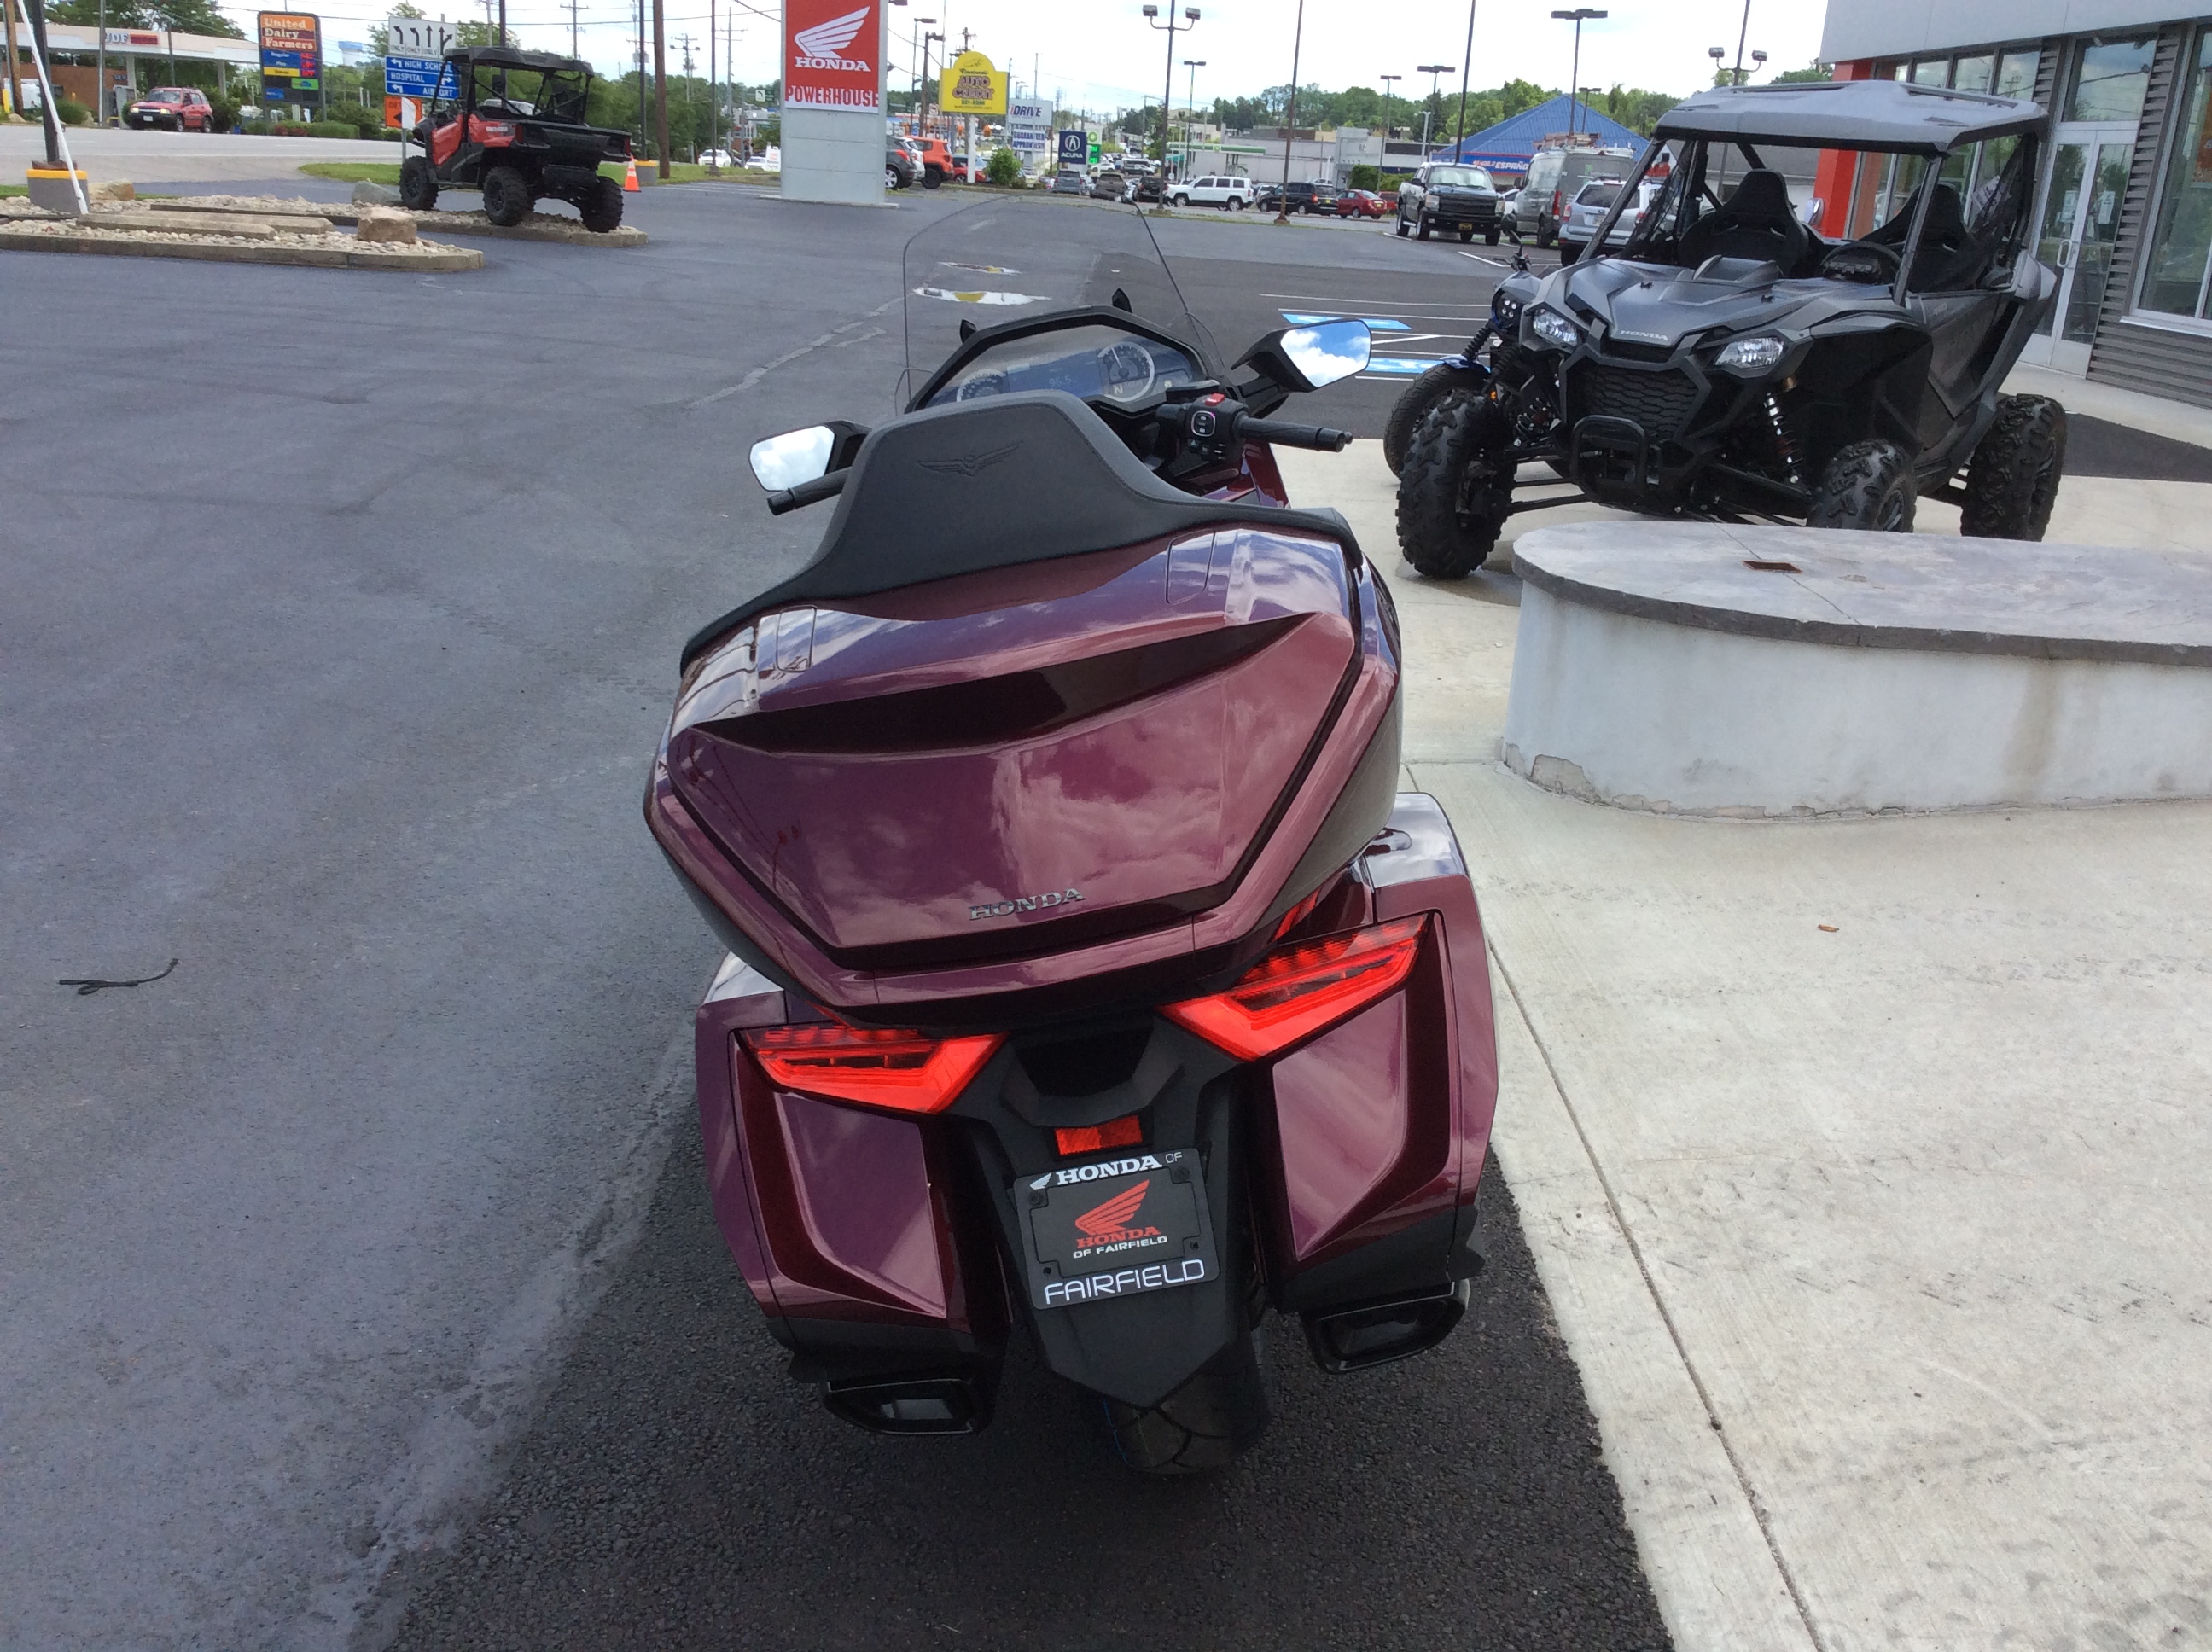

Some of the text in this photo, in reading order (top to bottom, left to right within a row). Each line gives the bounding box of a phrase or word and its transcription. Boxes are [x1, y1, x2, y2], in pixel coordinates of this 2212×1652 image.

[265, 18, 306, 29] United
[265, 28, 299, 39] Dairy
[265, 38, 313, 49] Farmers
[404, 61, 422, 69] HIGH
[795, 56, 871, 73] HONDA
[391, 73, 425, 84] HOSPITAL
[957, 75, 992, 87] AUTO
[422, 87, 453, 96] AIRORT
[784, 84, 879, 108] POWERHOUSE
[952, 87, 995, 100] CREDIT
[1010, 104, 1043, 118] iDRIVE
[1621, 329, 1668, 340] HONDA
[969, 887, 1086, 921] HONDA
[1057, 1152, 1183, 1185] HONDA OF
[1075, 1226, 1161, 1248] HONDA
[1073, 1236, 1168, 1259] OF FAIRFIELD
[1044, 1259, 1205, 1305] FAIRFIELD
